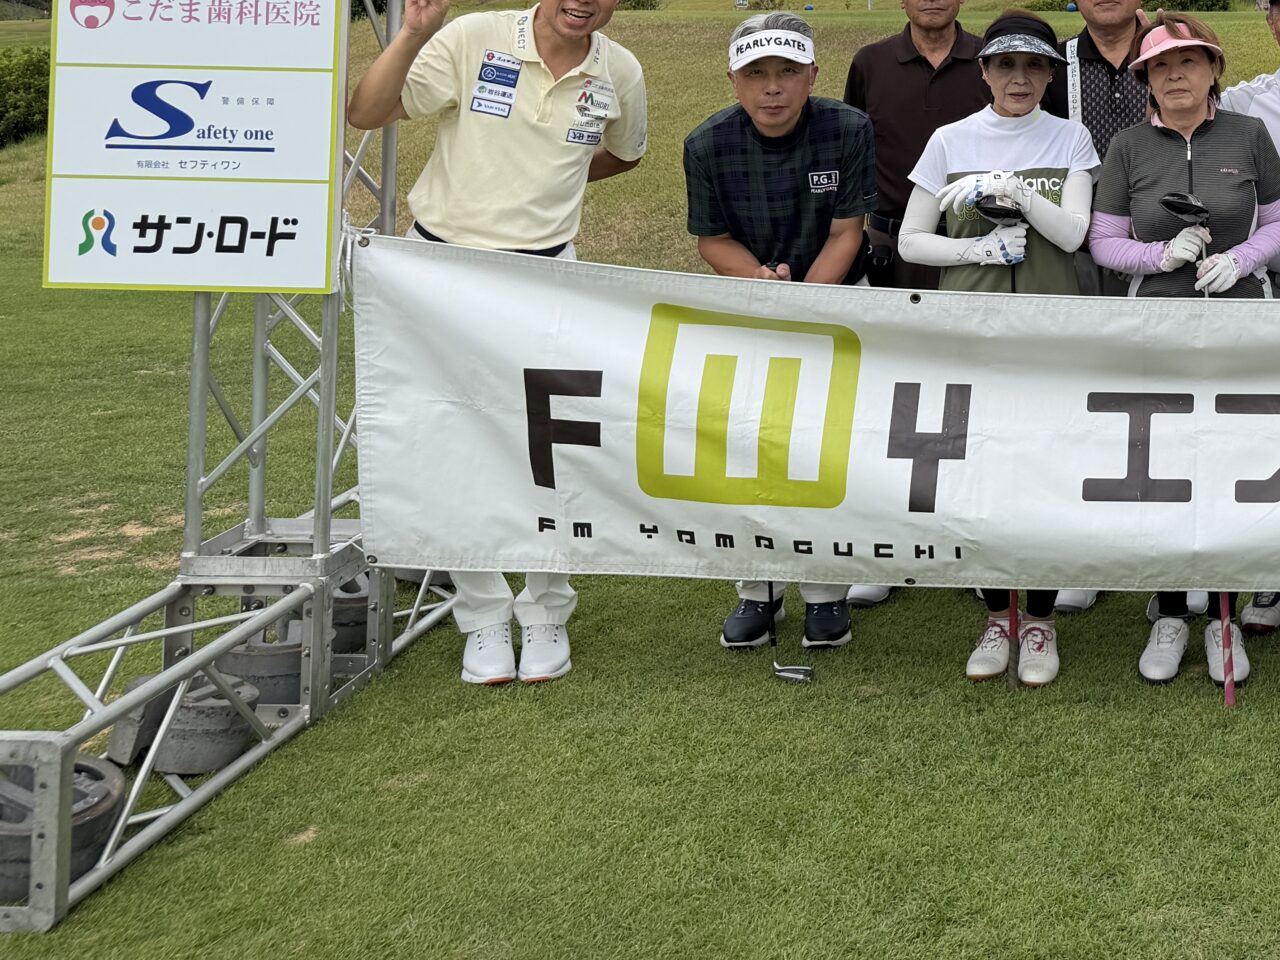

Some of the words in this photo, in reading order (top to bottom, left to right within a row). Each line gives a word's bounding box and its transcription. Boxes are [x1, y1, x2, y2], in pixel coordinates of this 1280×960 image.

[105, 79, 238, 143] Safety
[244, 128, 274, 141] one
[221, 96, 275, 106] 警備保障
[136, 160, 169, 170] 有限会社
[178, 159, 241, 171] セフティワン
[132, 214, 299, 257] サン・ロード
[538, 516, 593, 538] FM
[640, 524, 962, 560] YAMAGUCHI
